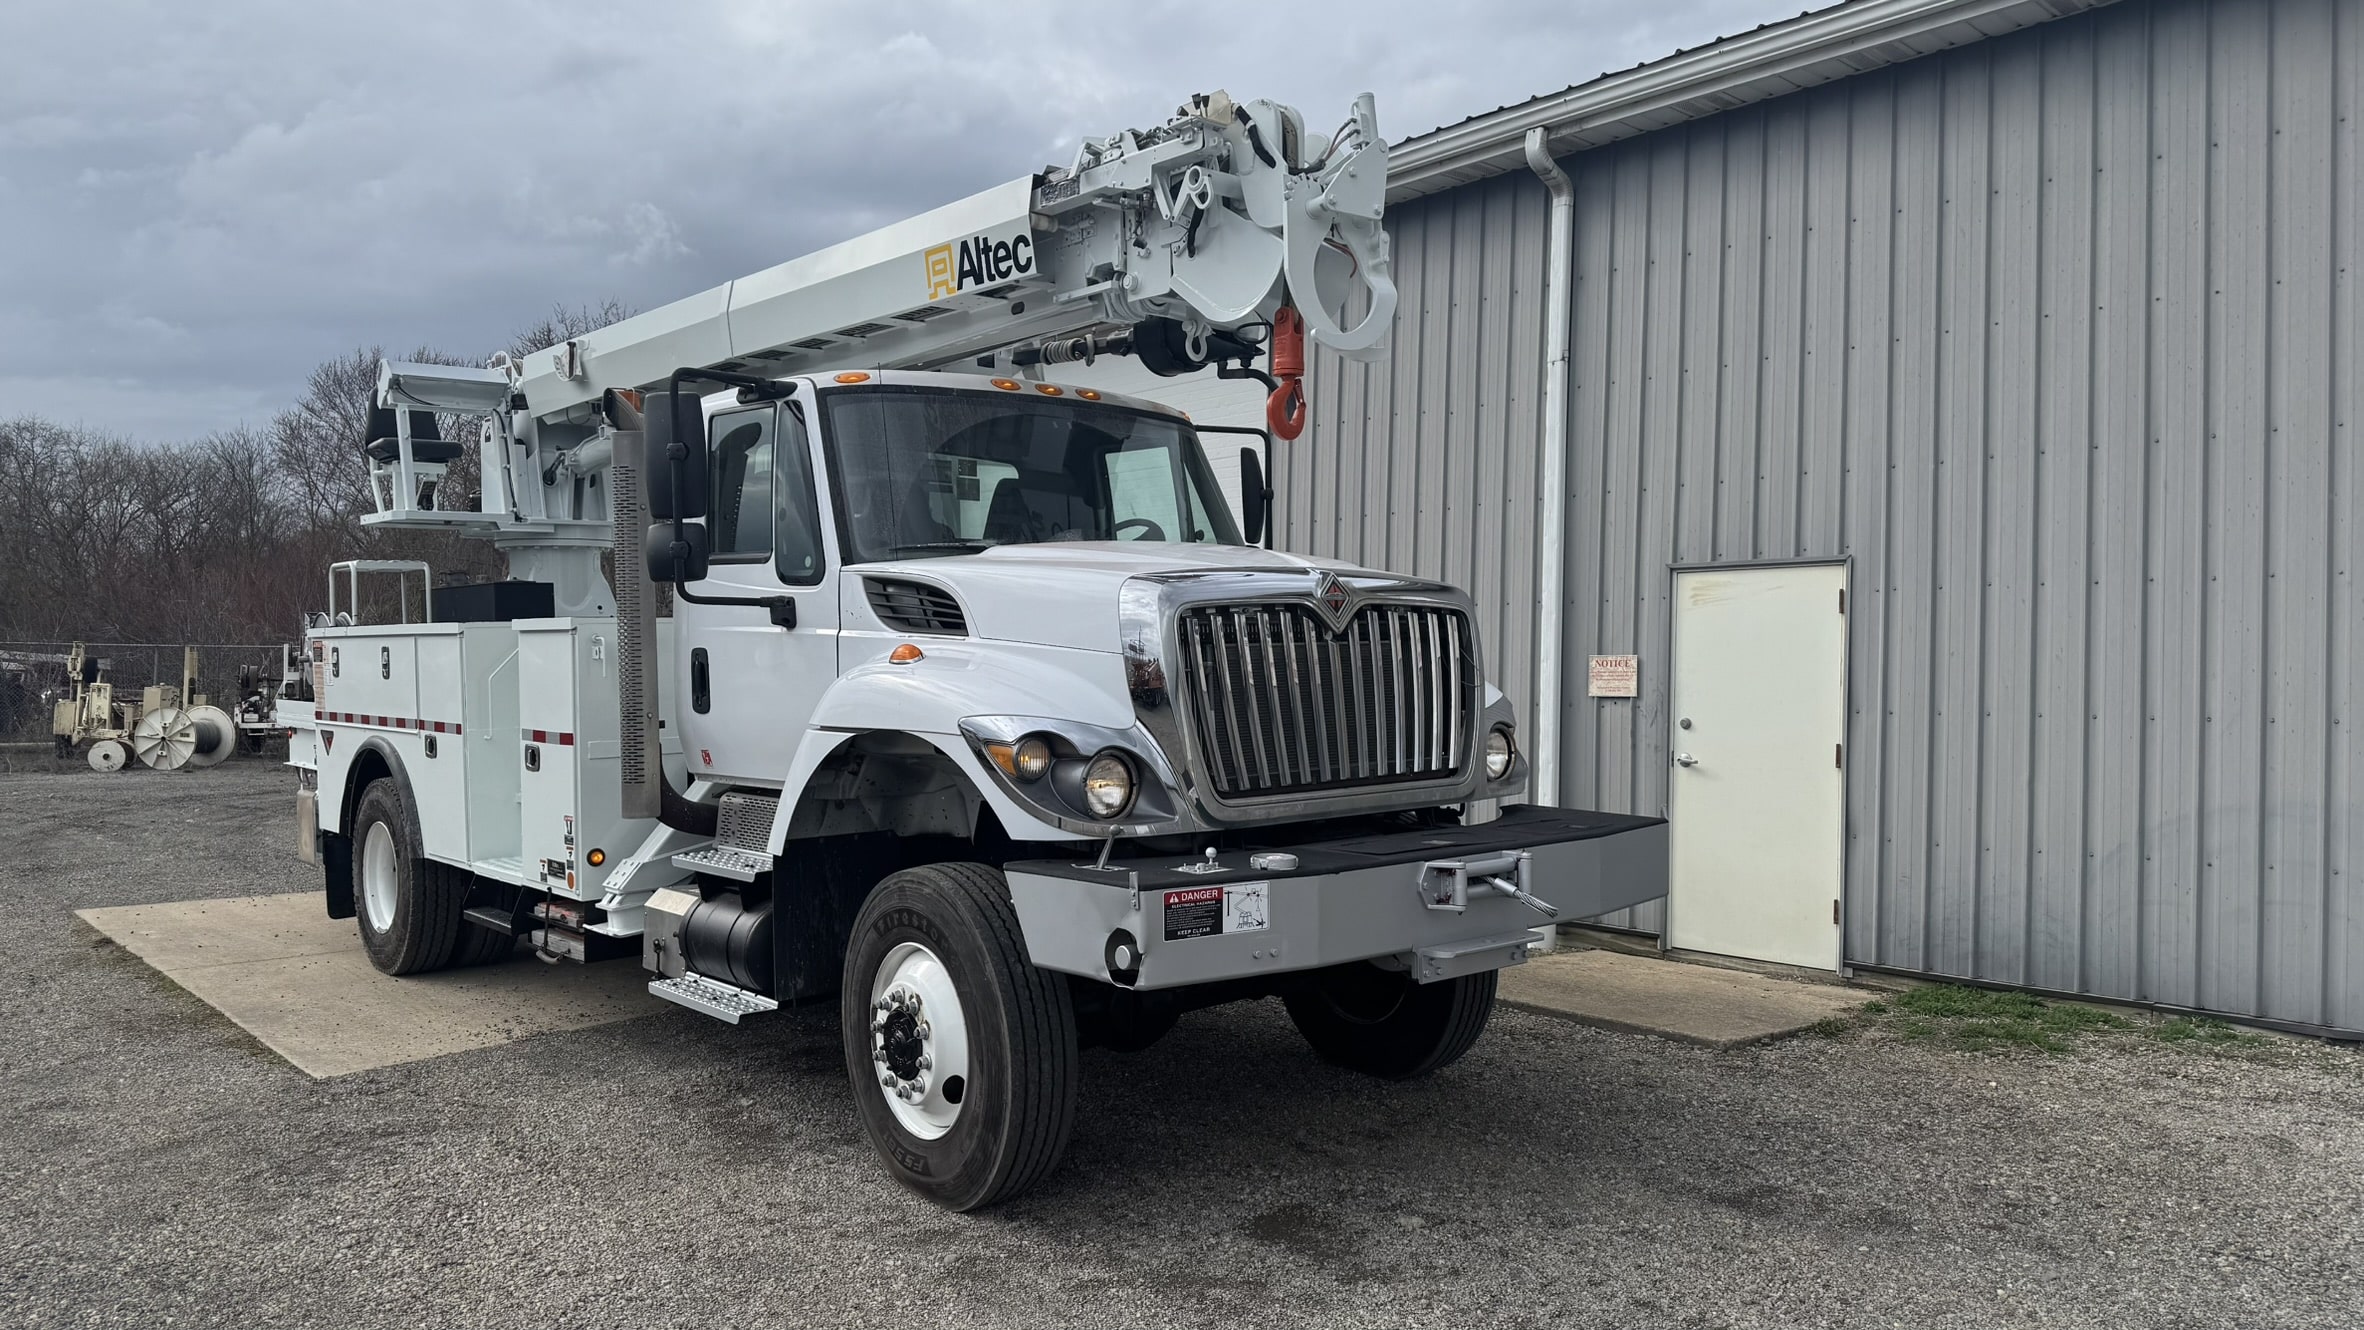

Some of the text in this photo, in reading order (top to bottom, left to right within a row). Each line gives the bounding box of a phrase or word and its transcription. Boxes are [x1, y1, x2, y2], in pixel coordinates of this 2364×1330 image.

[957, 234, 1033, 291] Altec
[1595, 660, 1631, 668] NOTICE
[1181, 890, 1218, 901] DANGER
[876, 911, 960, 968] Fireston
